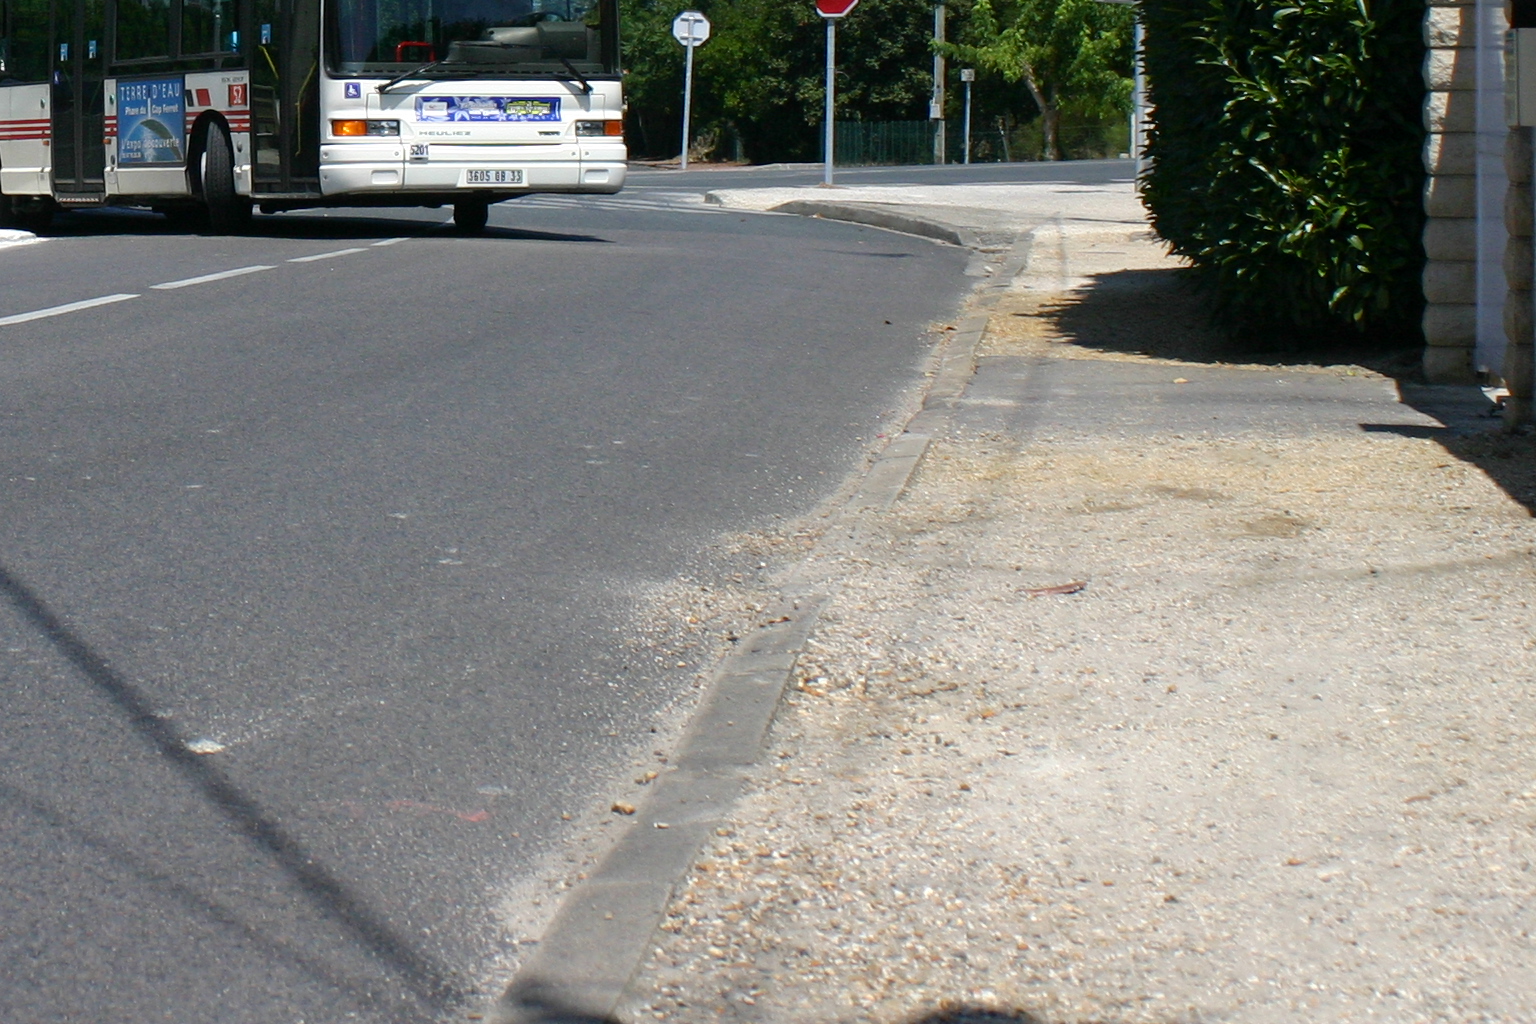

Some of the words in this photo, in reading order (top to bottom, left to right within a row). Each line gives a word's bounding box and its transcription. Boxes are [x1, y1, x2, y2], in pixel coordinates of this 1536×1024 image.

[120, 84, 147, 101] TERRE
[152, 82, 180, 99] D'EAU
[467, 170, 491, 182] 3605
[510, 170, 521, 182] 33
